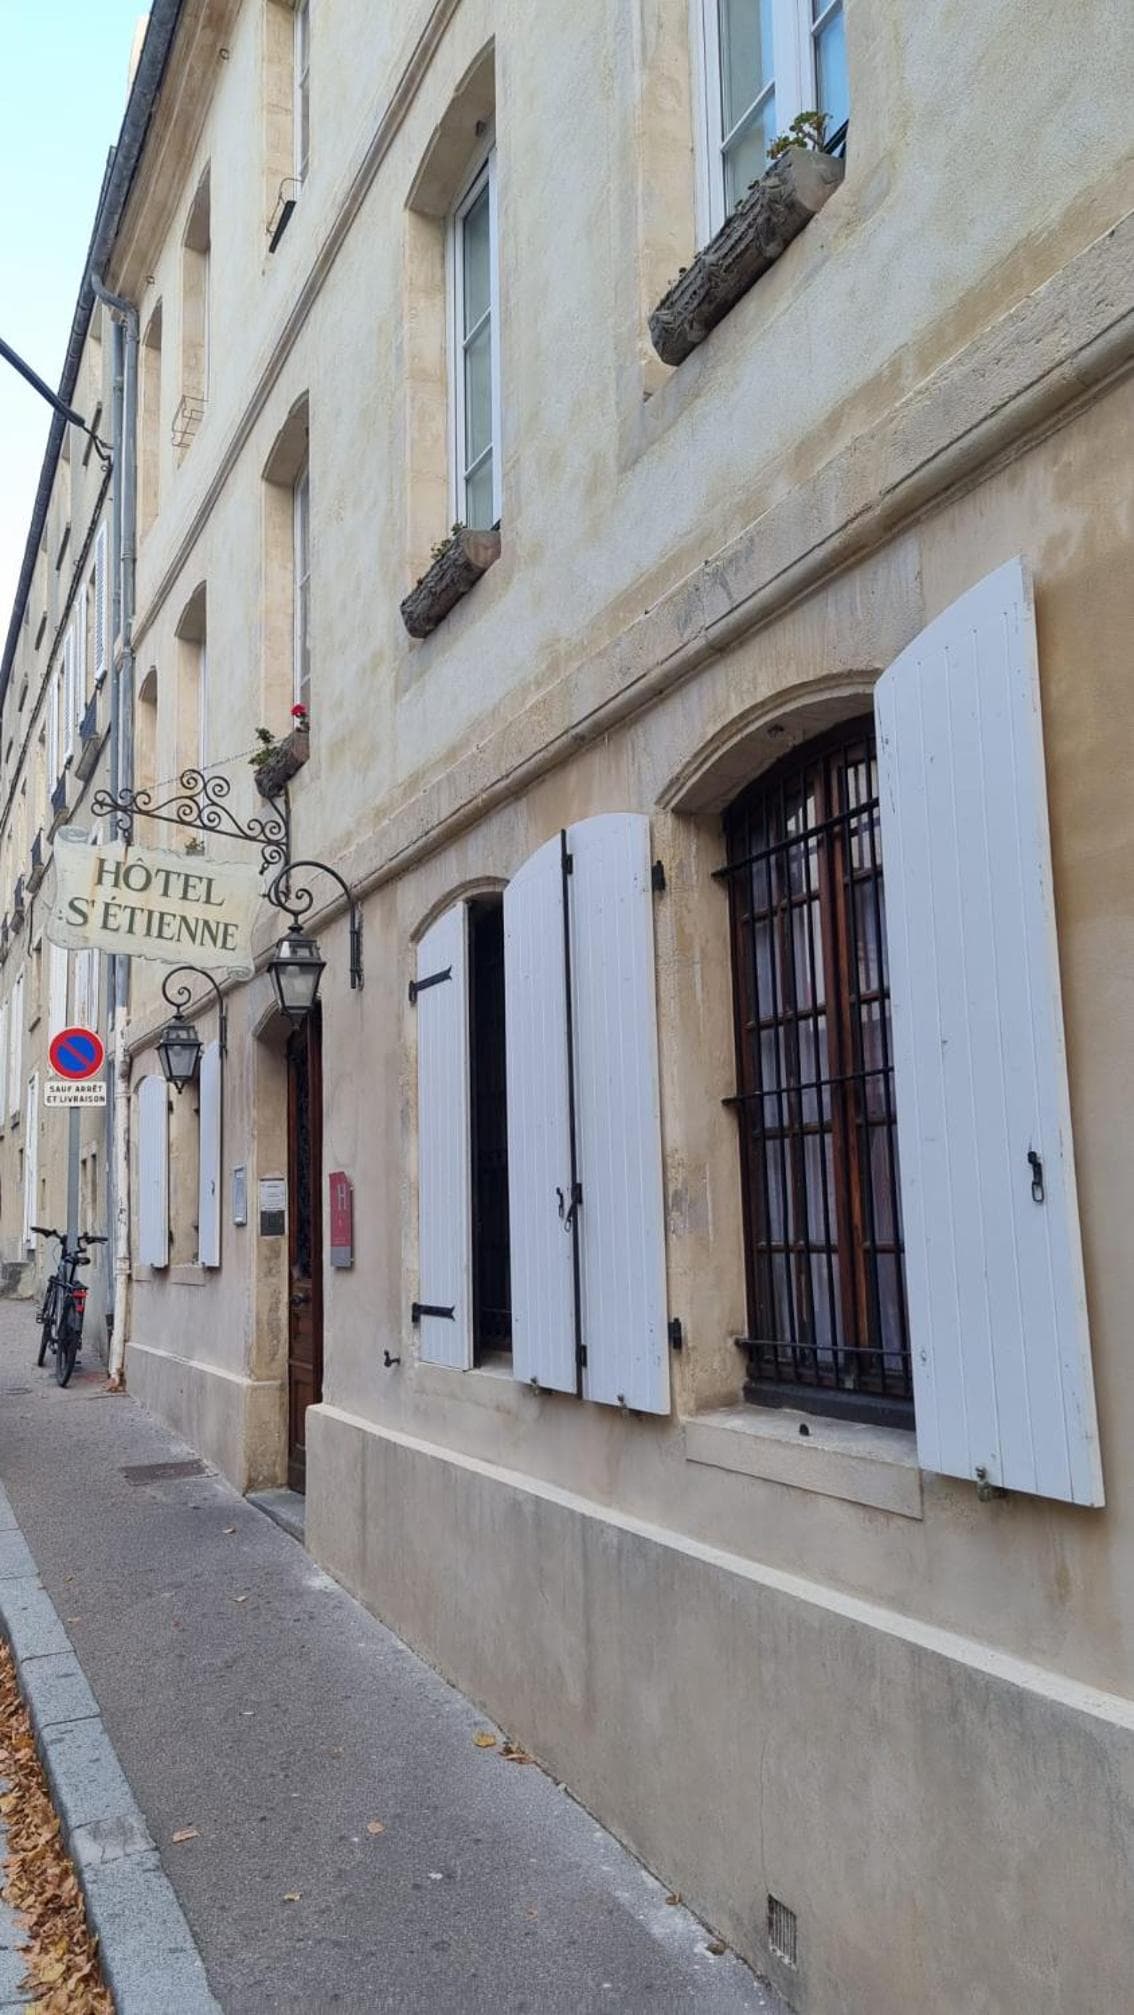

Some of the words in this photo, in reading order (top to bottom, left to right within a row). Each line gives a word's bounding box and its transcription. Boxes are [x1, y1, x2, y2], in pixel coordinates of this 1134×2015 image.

[95, 856, 226, 907] HÔTEL
[49, 1085, 72, 1093] SAUF
[47, 1095, 57, 1103] ET
[60, 1095, 106, 1103] LIVRAISON
[337, 1183, 347, 1210] H
